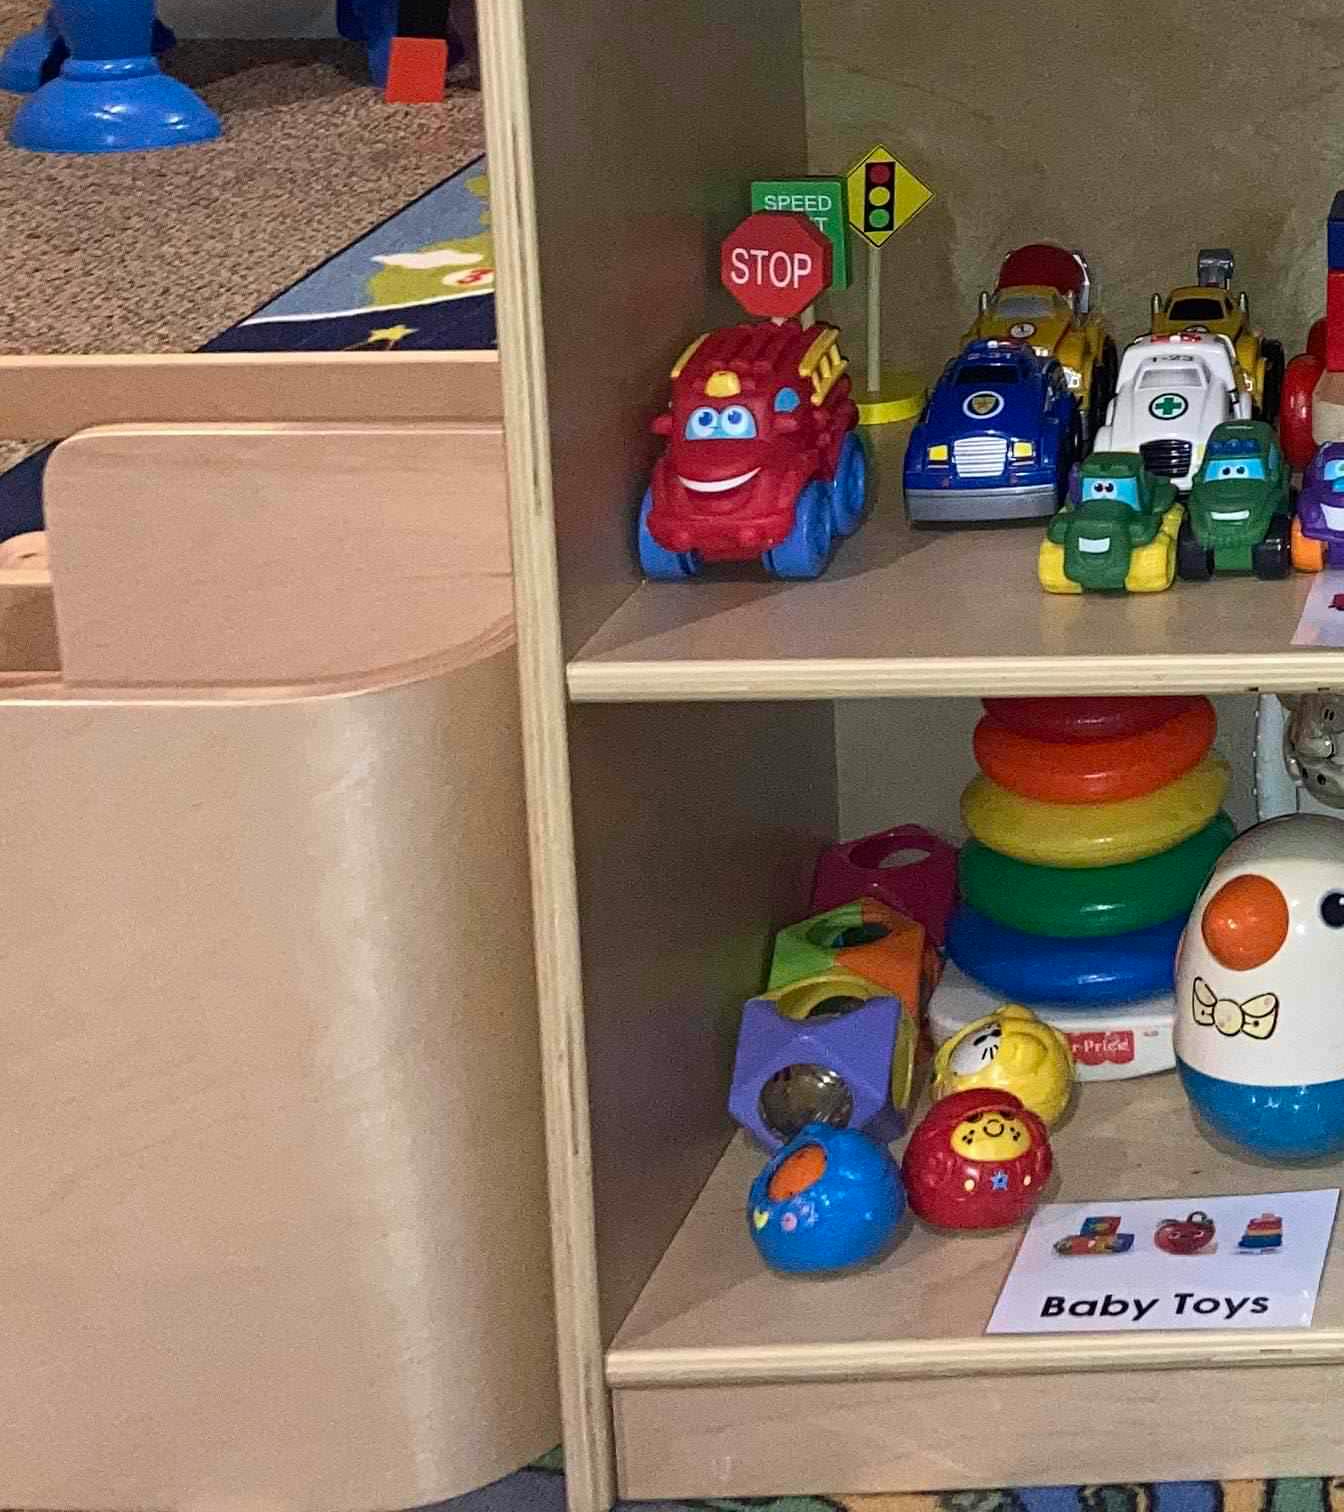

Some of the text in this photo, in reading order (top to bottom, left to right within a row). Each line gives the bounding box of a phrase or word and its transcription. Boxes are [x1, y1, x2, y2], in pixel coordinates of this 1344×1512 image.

[764, 195, 832, 211] SPEED
[731, 247, 812, 289] STOP
[1040, 1292, 1270, 1321] Baby Toys
